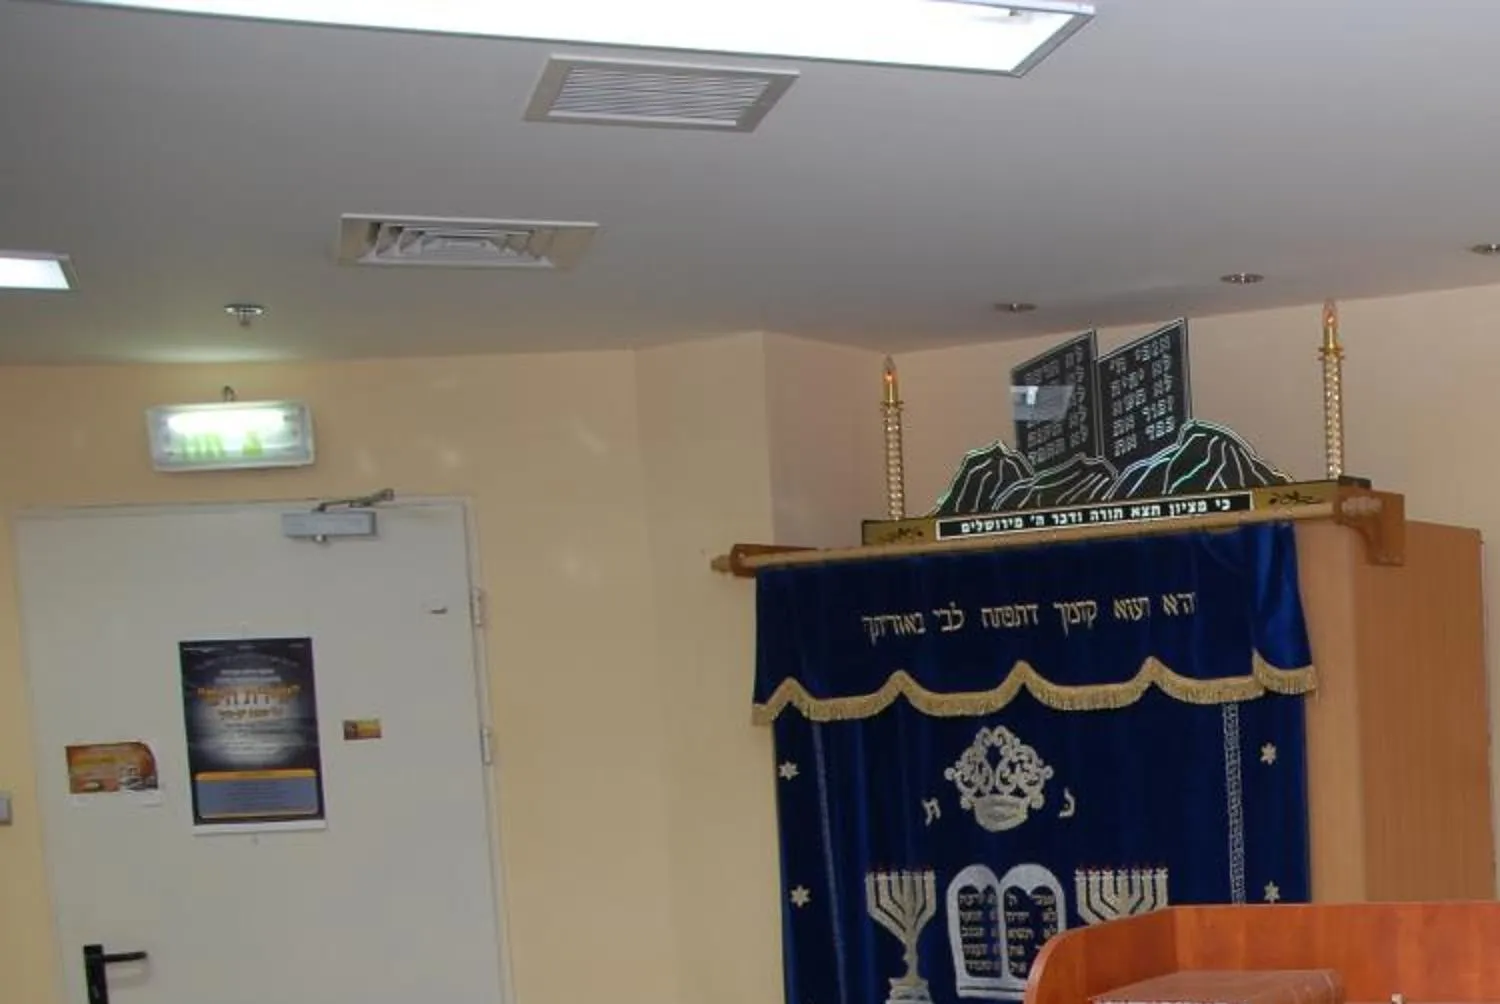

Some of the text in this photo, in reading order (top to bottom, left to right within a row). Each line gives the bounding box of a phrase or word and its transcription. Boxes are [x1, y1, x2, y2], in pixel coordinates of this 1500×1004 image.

[1130, 503, 1162, 518] תצא
[1168, 500, 1208, 519] מציון
[1214, 498, 1232, 512] כי
[1051, 511, 1084, 526] ודבר
[1089, 507, 1124, 522] תורה
[960, 516, 1024, 533] מירושלים
